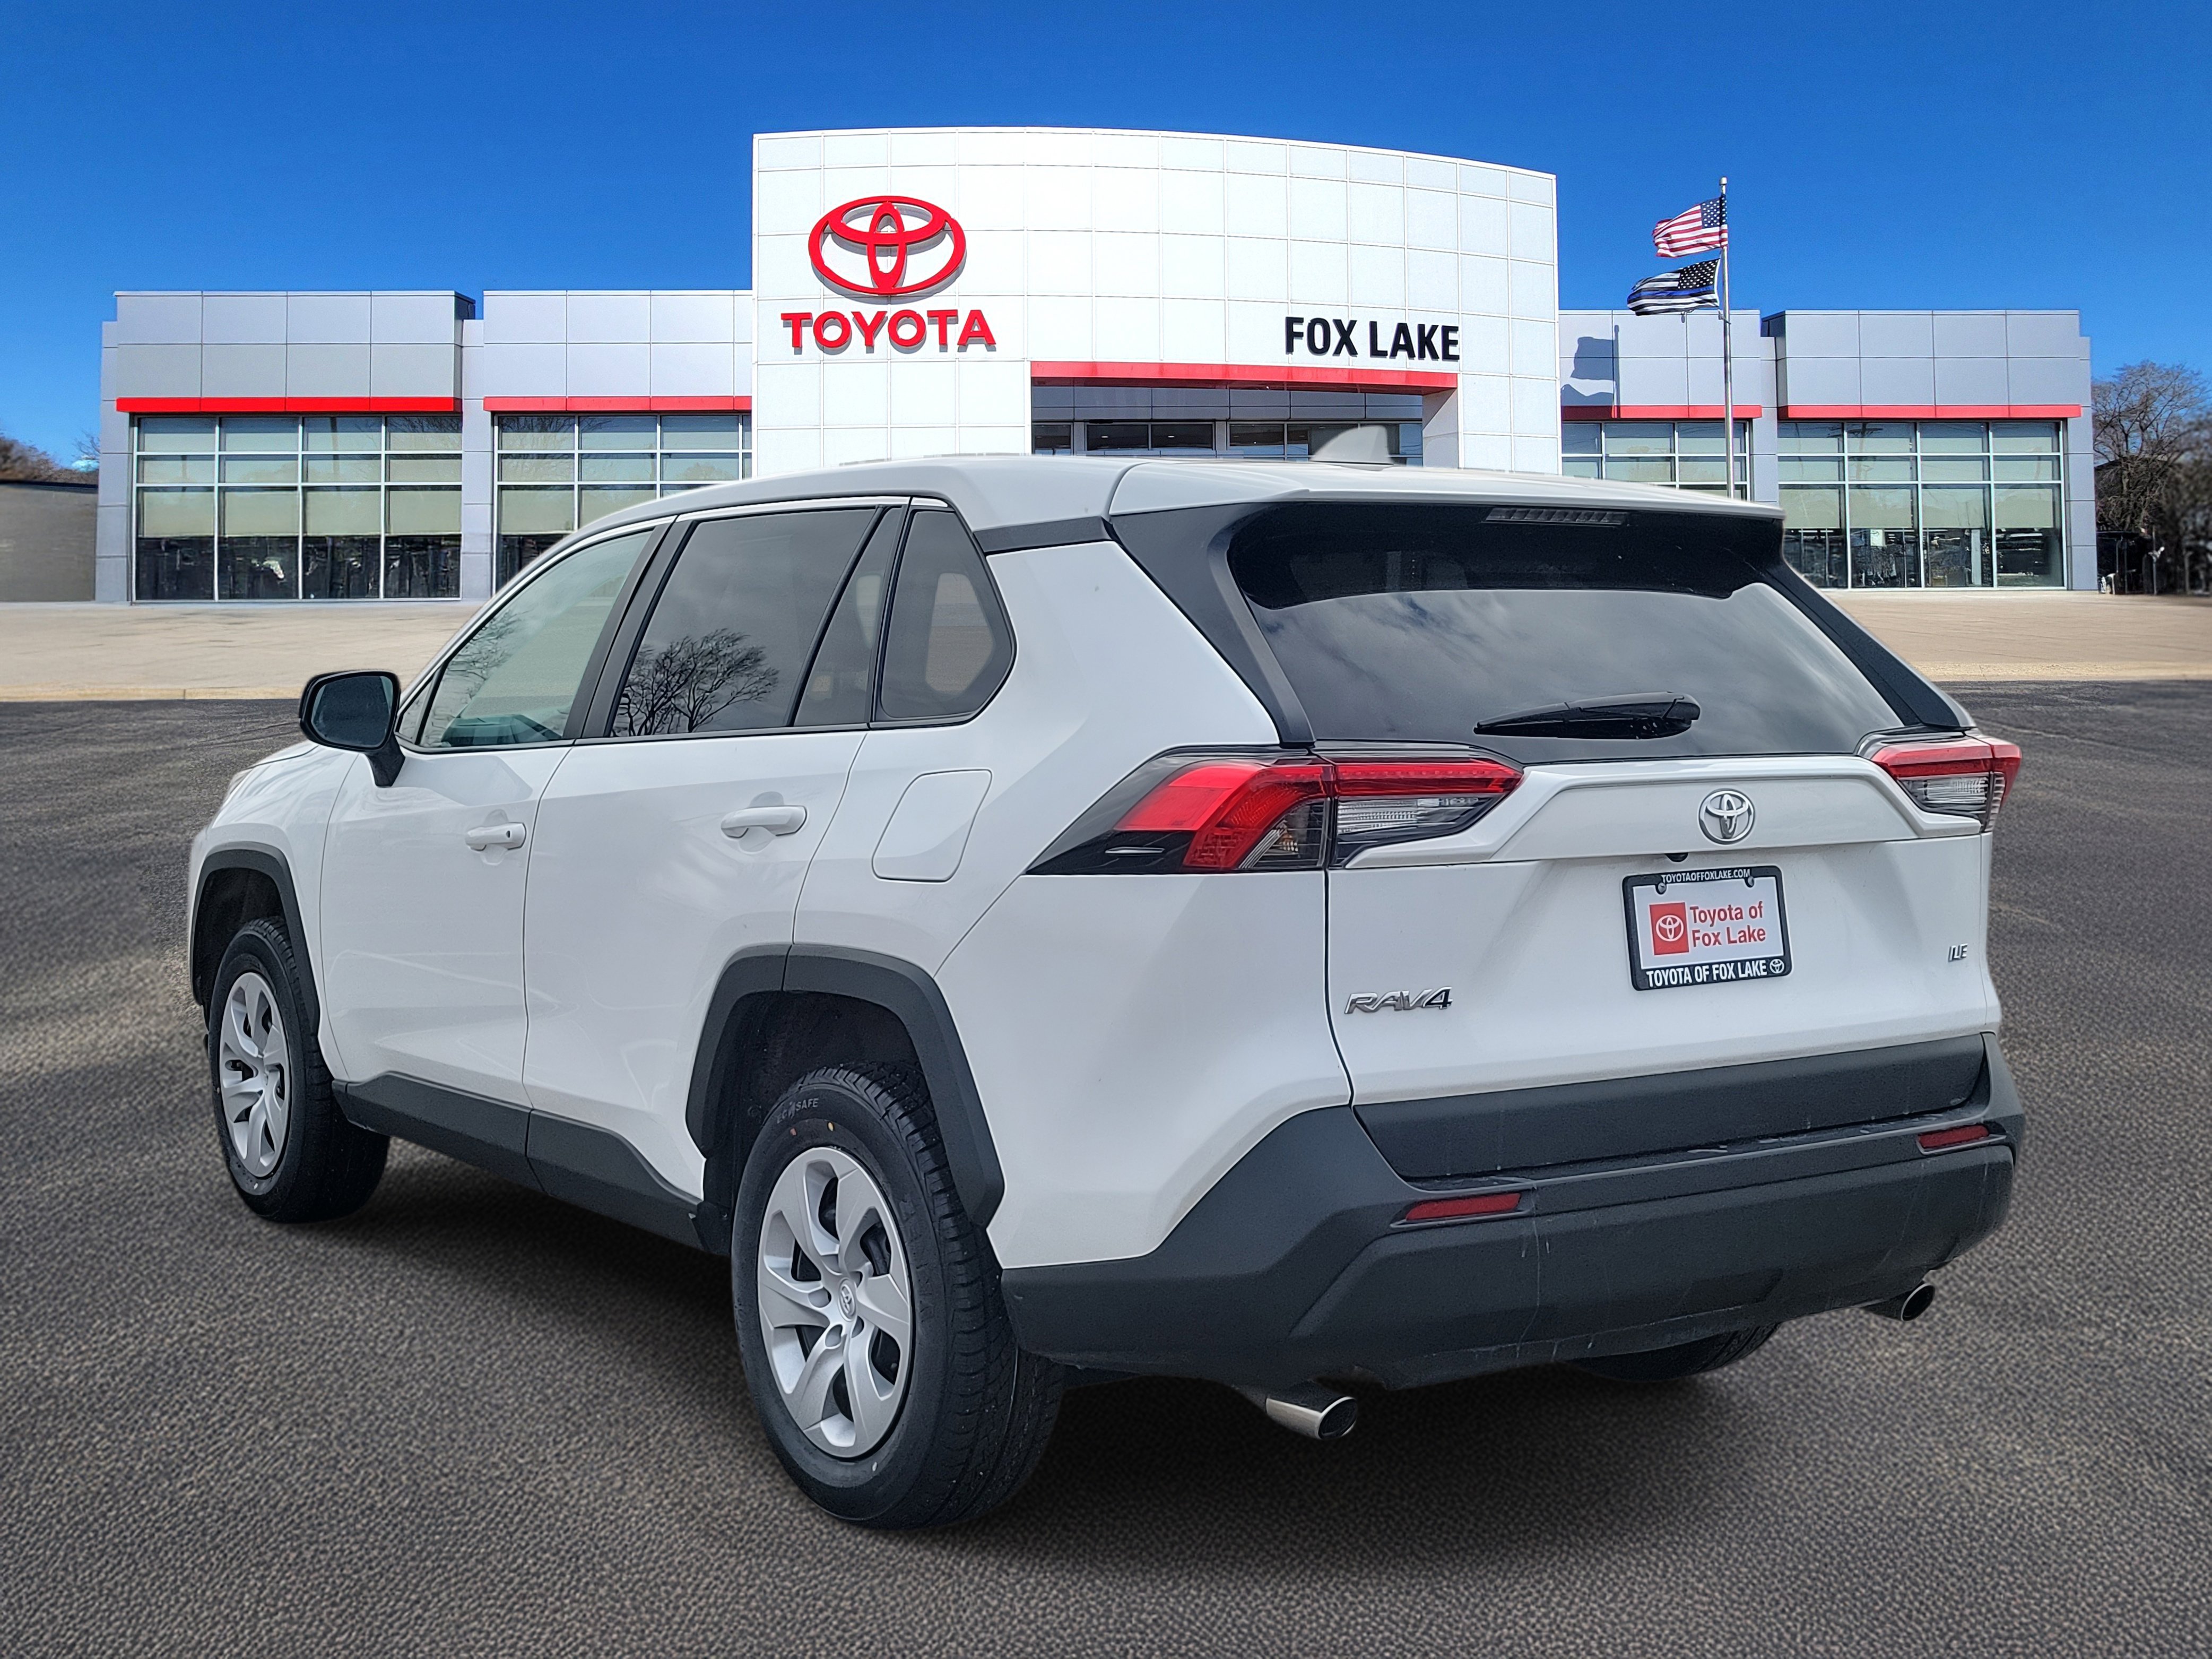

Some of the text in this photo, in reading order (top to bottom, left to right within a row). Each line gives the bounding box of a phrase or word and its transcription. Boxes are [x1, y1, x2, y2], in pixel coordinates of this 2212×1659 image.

[781, 309, 996, 348] TOYOTA
[1285, 317, 1460, 361] FOX LAKE
[1661, 868, 1750, 883] TOYOTAOFFOXLAKE.COM
[1689, 901, 1763, 927] Toyota of
[1691, 925, 1766, 947] Fox Lake
[1646, 960, 1767, 988] TOYOTA OF FOX LAKE
[1344, 986, 1453, 1014] RAV4
